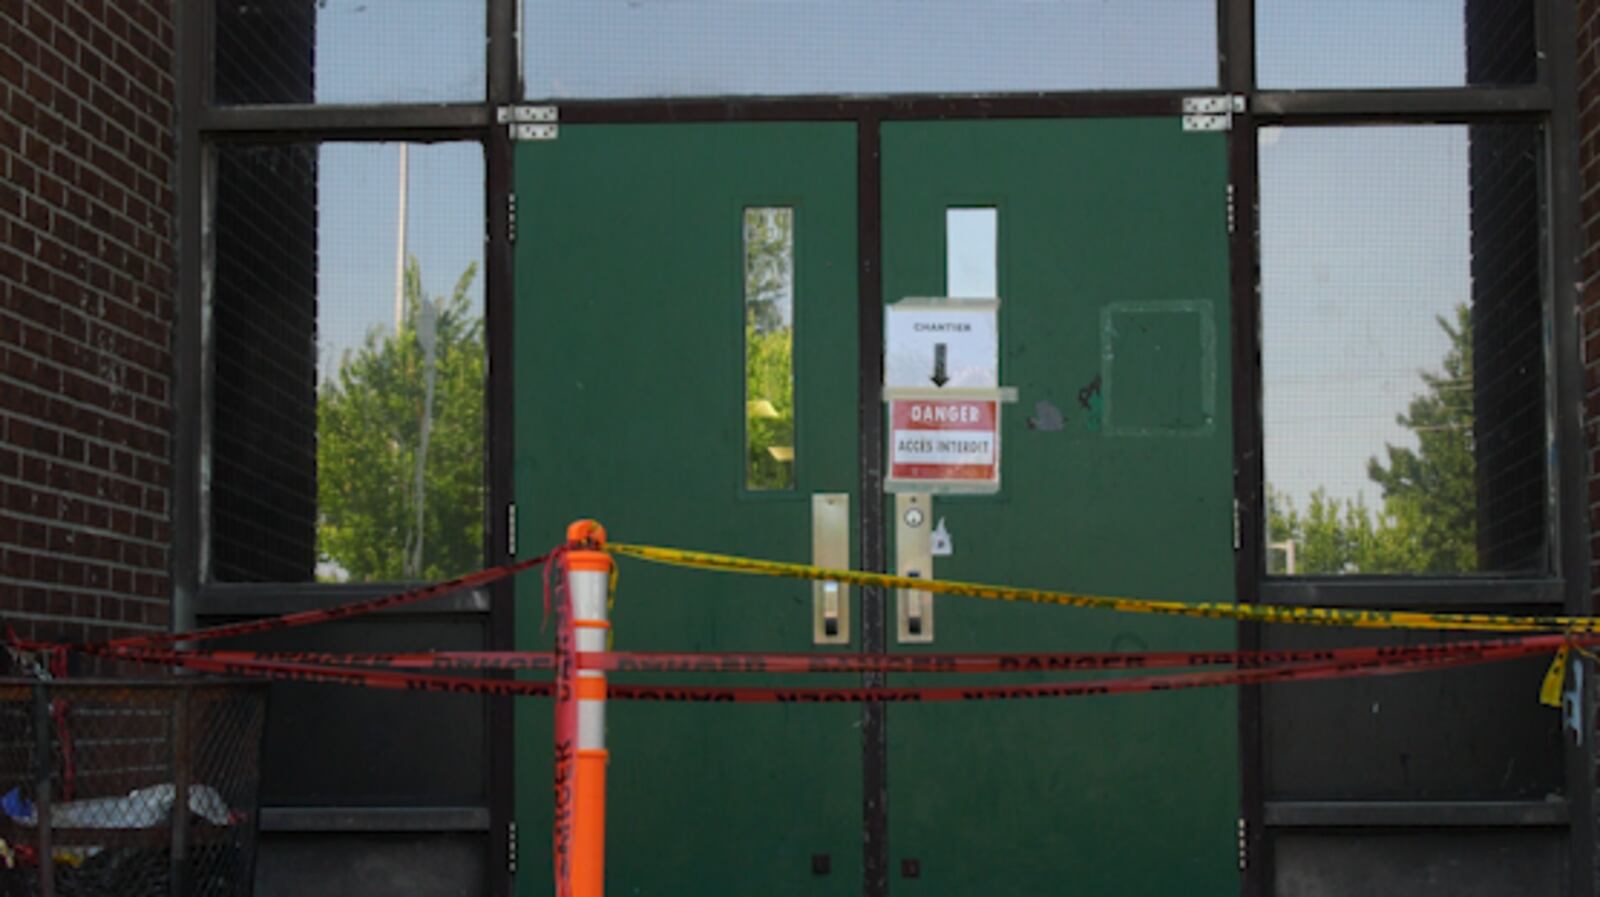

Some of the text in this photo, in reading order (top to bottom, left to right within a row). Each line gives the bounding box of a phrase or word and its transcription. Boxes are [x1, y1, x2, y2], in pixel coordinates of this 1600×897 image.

[912, 322, 972, 332] CHANTIER
[910, 405, 980, 422] DANGER
[937, 440, 989, 454] INTERDIT
